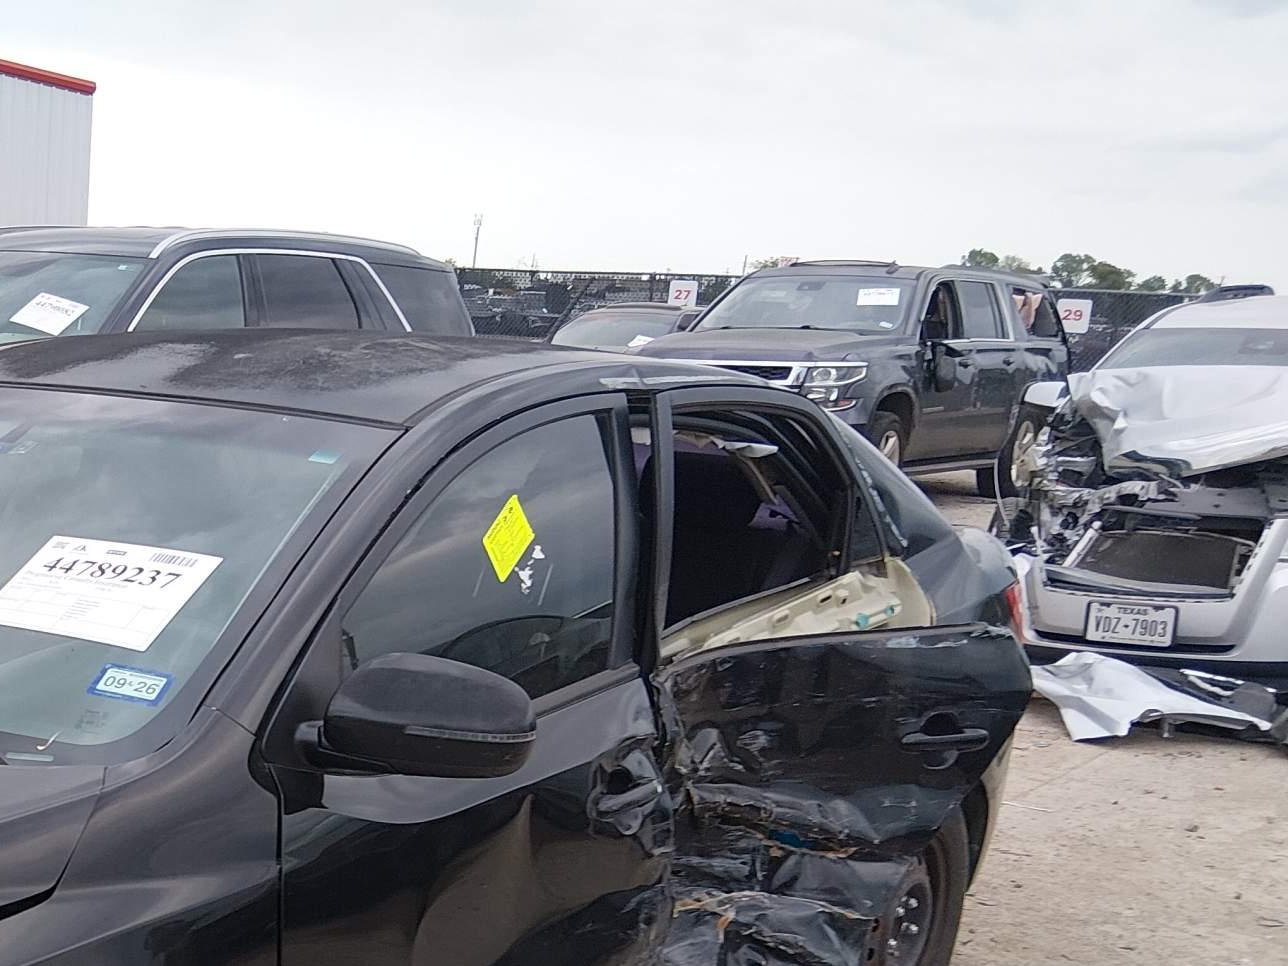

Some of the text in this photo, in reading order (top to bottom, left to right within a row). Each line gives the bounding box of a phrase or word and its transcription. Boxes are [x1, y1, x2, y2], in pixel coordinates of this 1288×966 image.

[674, 289, 691, 300] 27
[1063, 309, 1083, 321] 29
[43, 557, 183, 589] 44789237
[1117, 606, 1149, 616] TEXAS
